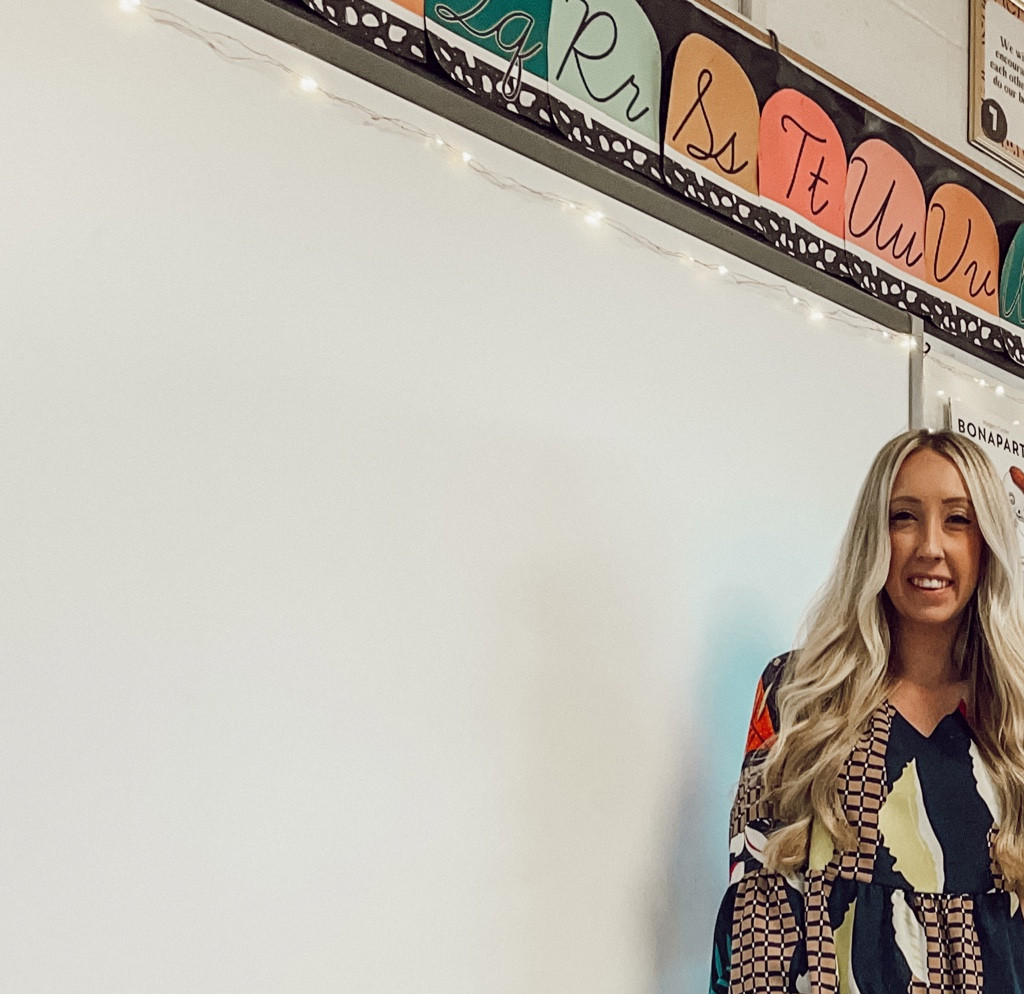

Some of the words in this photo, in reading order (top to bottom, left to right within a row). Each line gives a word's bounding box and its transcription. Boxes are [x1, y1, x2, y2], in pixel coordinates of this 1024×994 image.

[1000, 35, 1014, 54] We
[989, 60, 1008, 79] each
[993, 75, 1003, 89] do
[1003, 85, 1016, 98] our
[989, 104, 998, 132] 1
[555, 0, 650, 122] Rr
[672, 68, 749, 174] Ss
[780, 114, 829, 215] Tt
[849, 156, 924, 267] Uu
[930, 202, 996, 298] Vv
